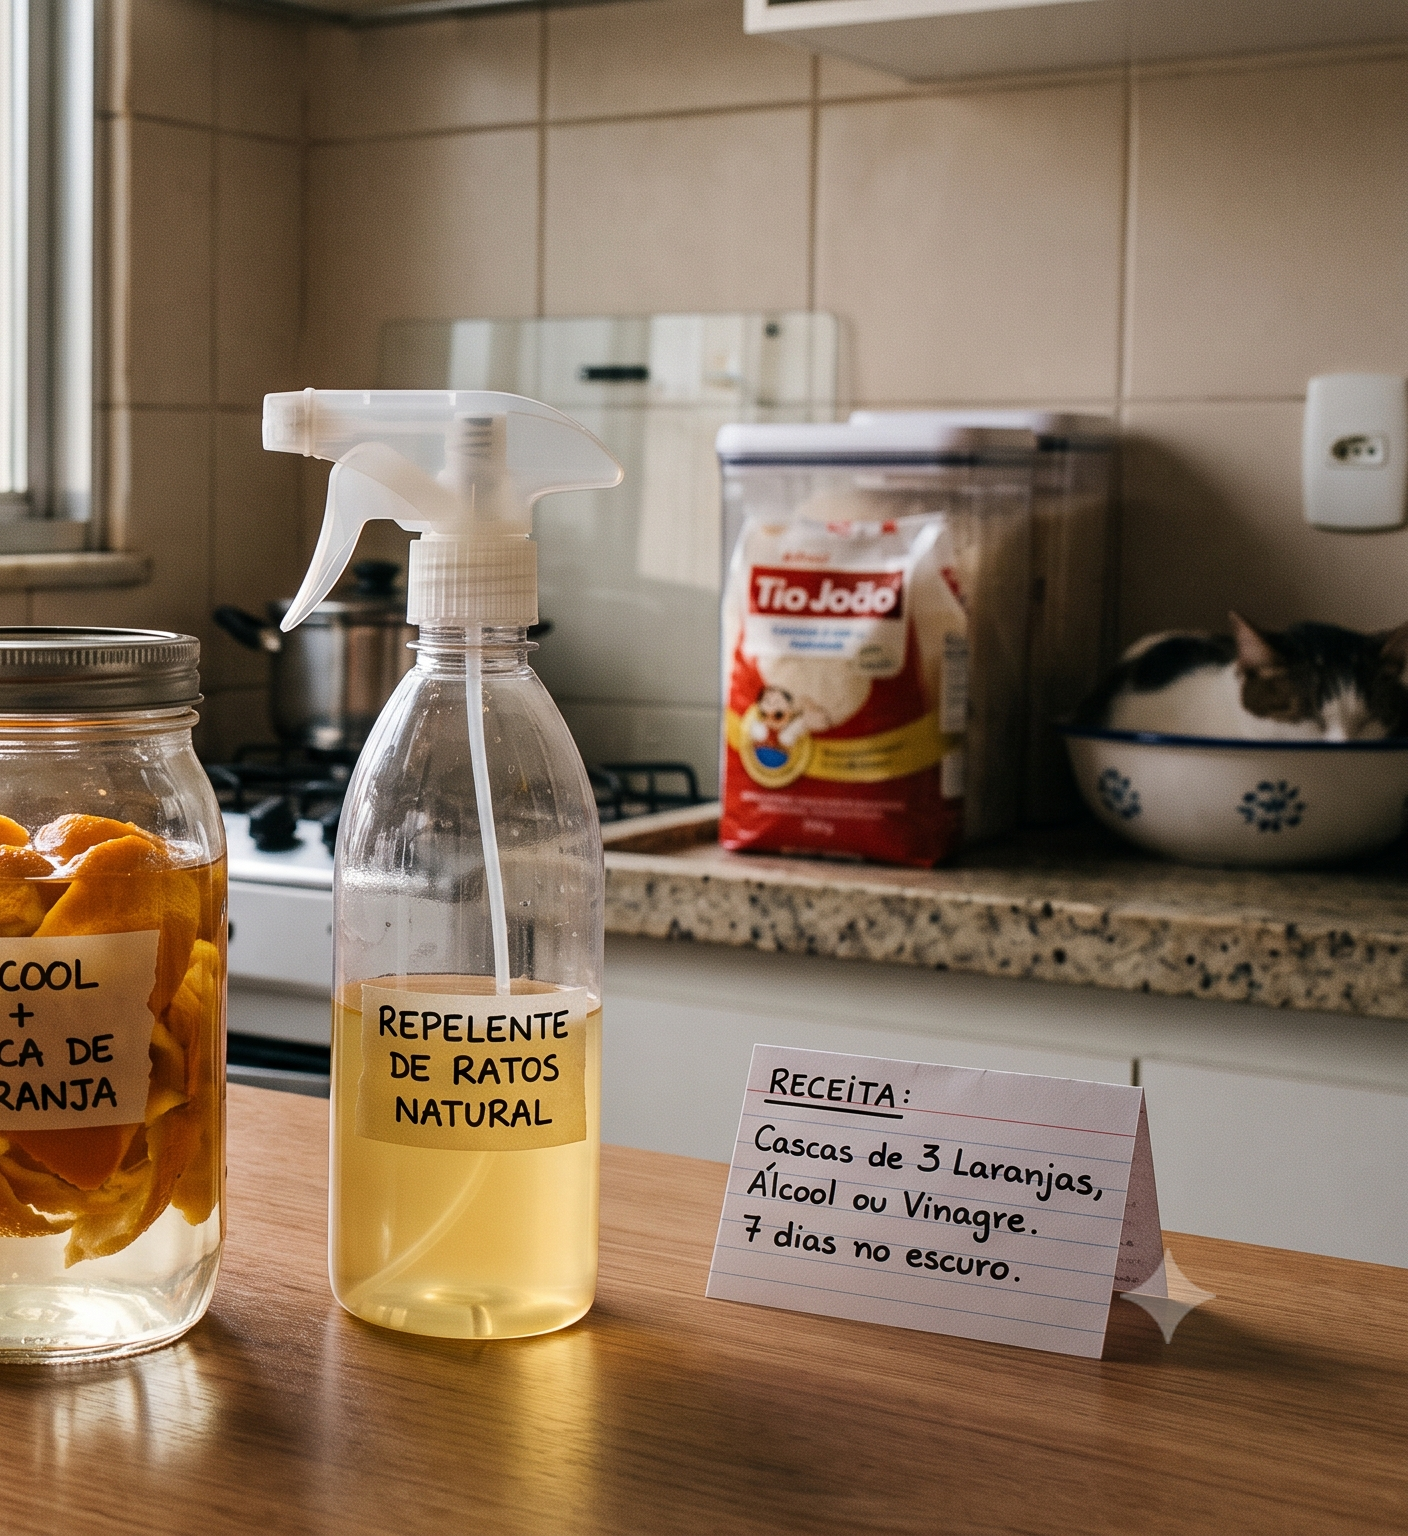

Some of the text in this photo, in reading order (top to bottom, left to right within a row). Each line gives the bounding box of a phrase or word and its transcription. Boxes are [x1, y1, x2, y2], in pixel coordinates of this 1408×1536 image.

[756, 576, 897, 613] Tio João
[379, 1005, 569, 1043] REPELENTE
[65, 1034, 114, 1066] DE
[390, 1051, 559, 1085] DE RATOS
[395, 1096, 553, 1128] NATURAL
[754, 1124, 1103, 1201] Cascas de 3 Laranjas,
[747, 1161, 1037, 1243] Álcool ou Vinagre.
[744, 1214, 1020, 1282] 7 dias no escuro.
